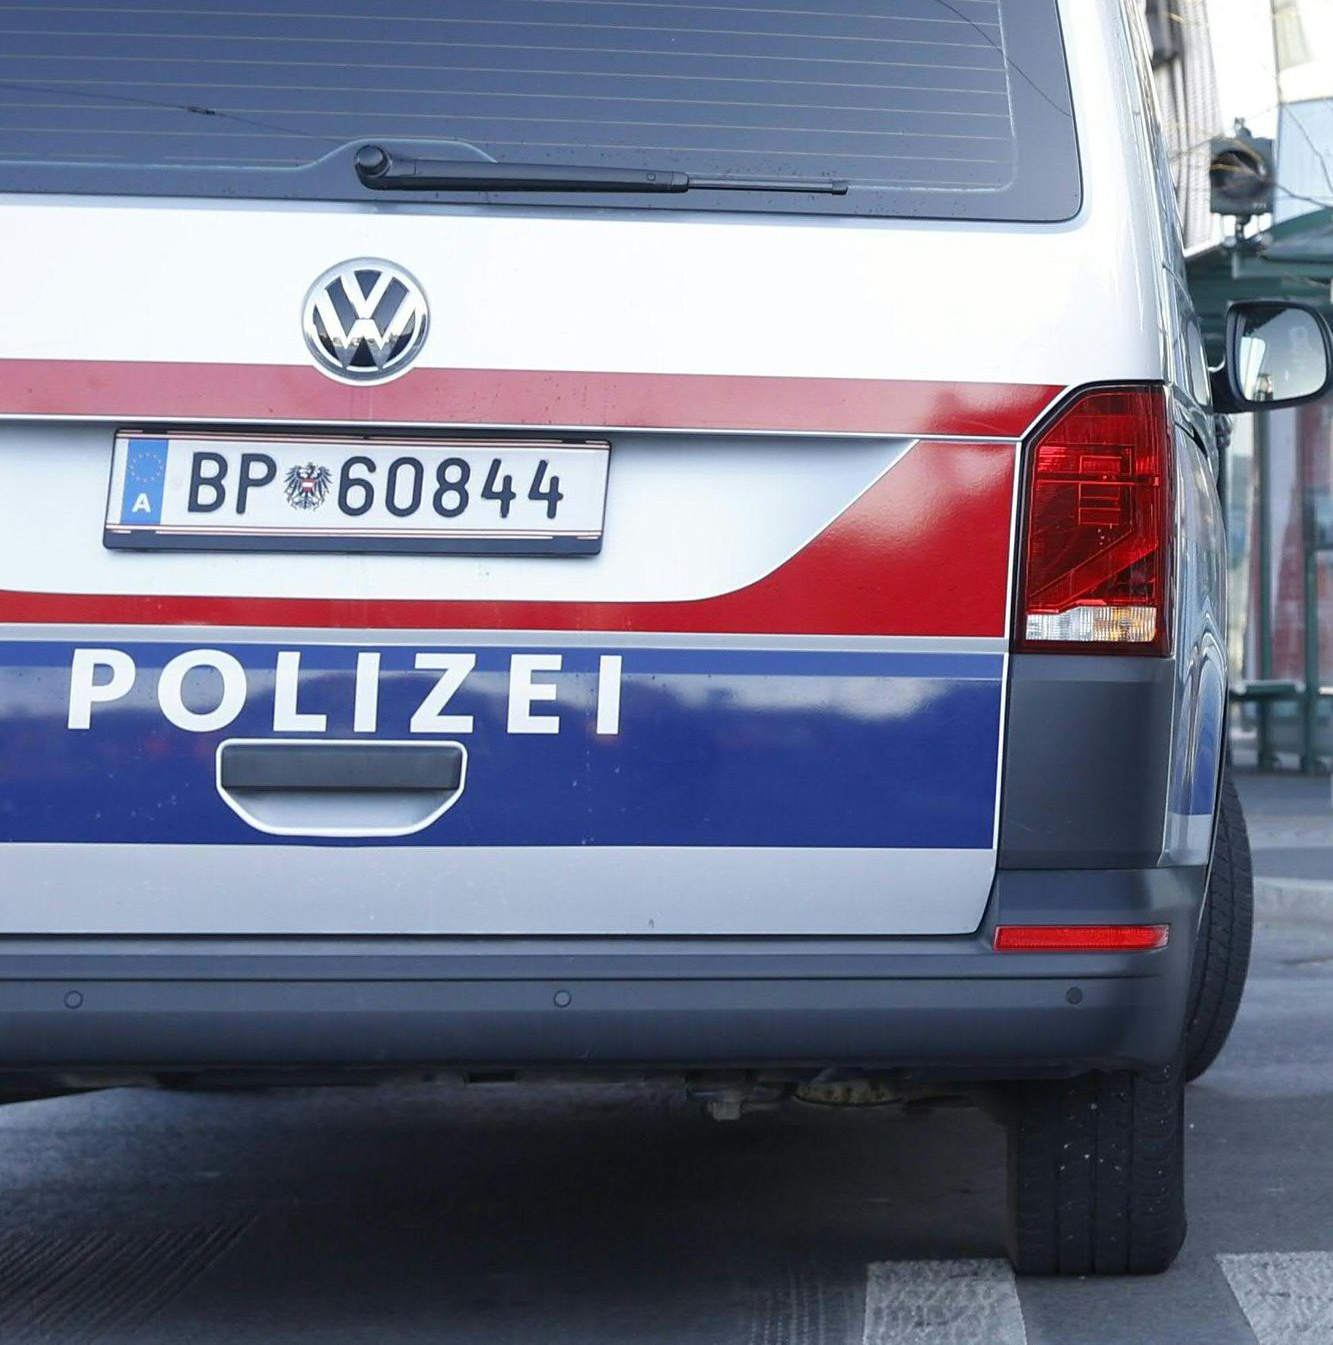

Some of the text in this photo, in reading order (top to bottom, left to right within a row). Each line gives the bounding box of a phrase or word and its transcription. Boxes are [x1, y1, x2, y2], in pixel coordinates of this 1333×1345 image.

[309, 264, 424, 374] VW
[130, 452, 564, 520] A BP 60844
[67, 647, 623, 736] POLIZEI
